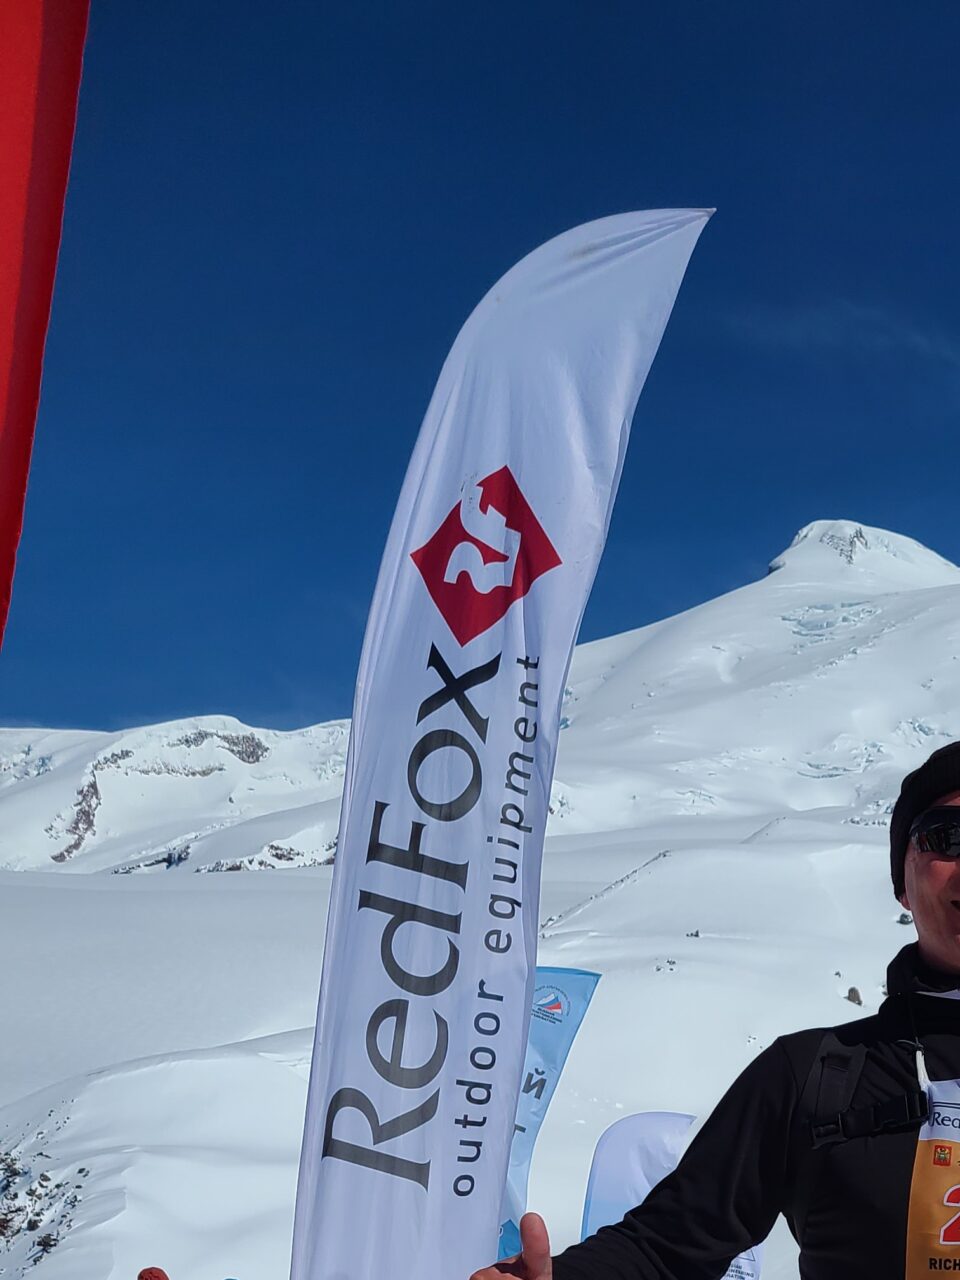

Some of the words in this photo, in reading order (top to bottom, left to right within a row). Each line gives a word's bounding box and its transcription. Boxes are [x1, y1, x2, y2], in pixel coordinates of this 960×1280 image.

[321, 641, 503, 1192] RedFox
[452, 978, 506, 1198] outdoor
[486, 654, 541, 955] equipment
